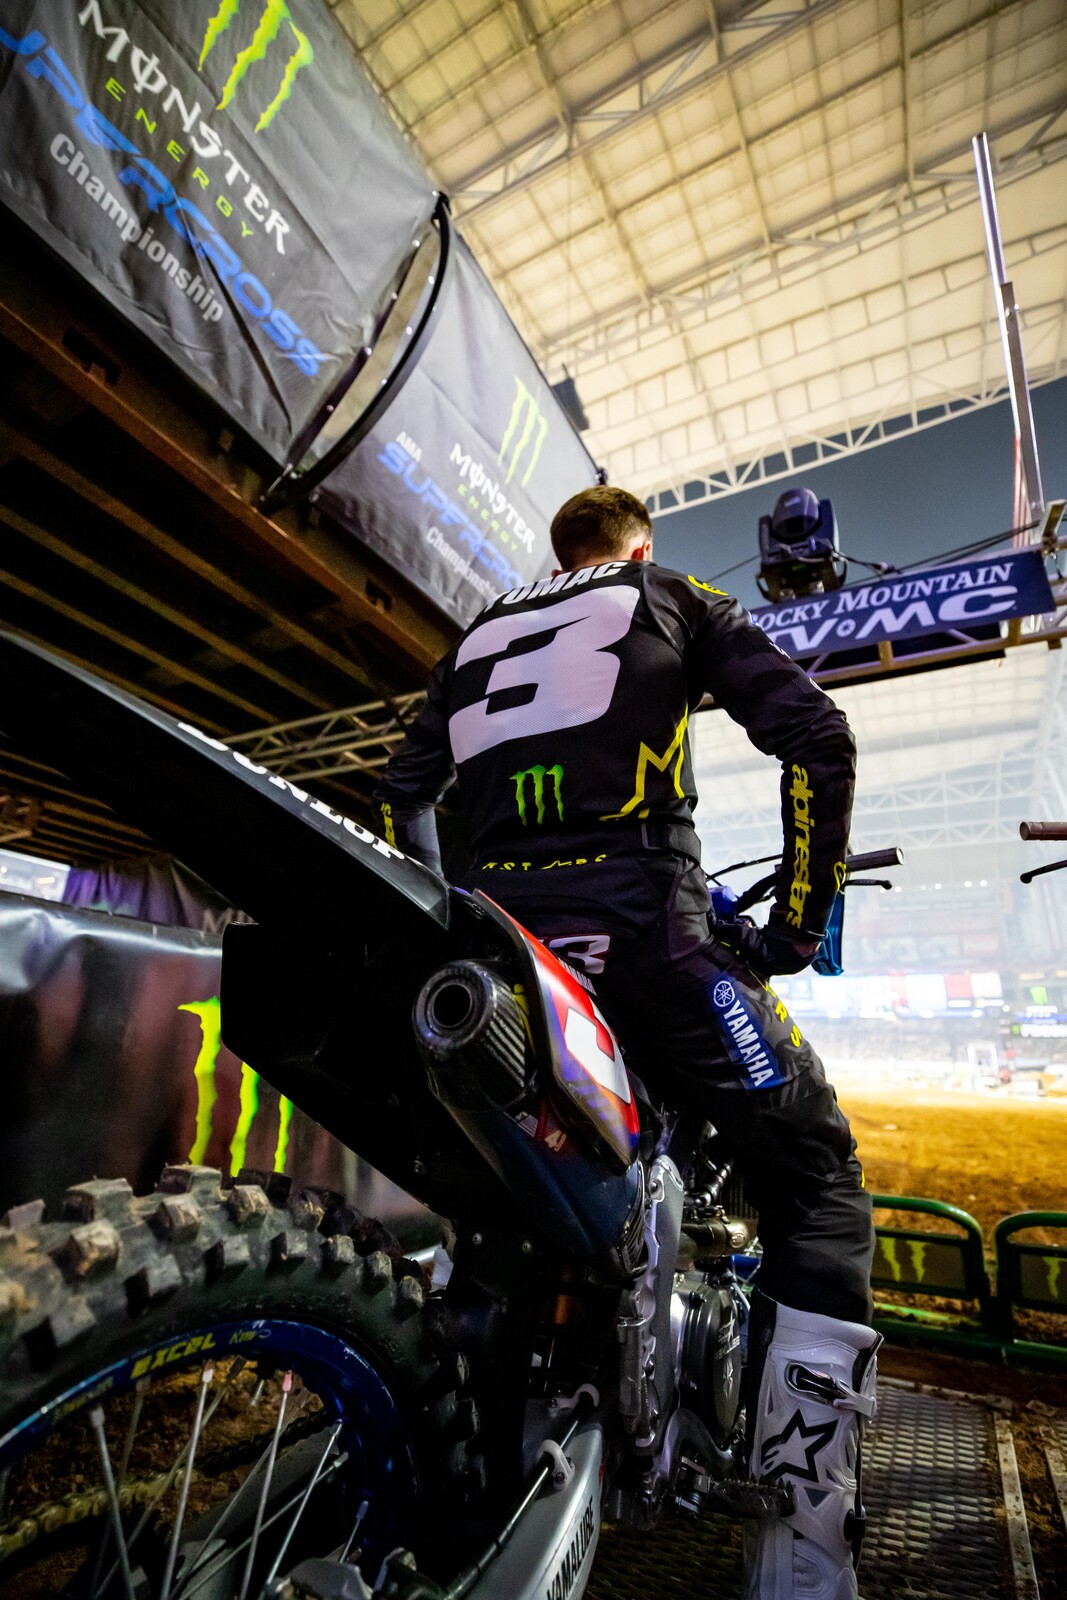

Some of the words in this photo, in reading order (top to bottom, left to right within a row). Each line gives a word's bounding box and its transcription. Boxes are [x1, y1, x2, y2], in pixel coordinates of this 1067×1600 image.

[78, 0, 293, 254] MONSTER
[105, 77, 253, 237] ENERGY
[50, 132, 224, 322] Championship
[450, 443, 535, 553] MONSTER
[484, 561, 627, 613] TOMAC
[834, 562, 1015, 614] MOUNTAIN
[449, 584, 641, 765] 3
[723, 1000, 774, 1087] YAMAHA
